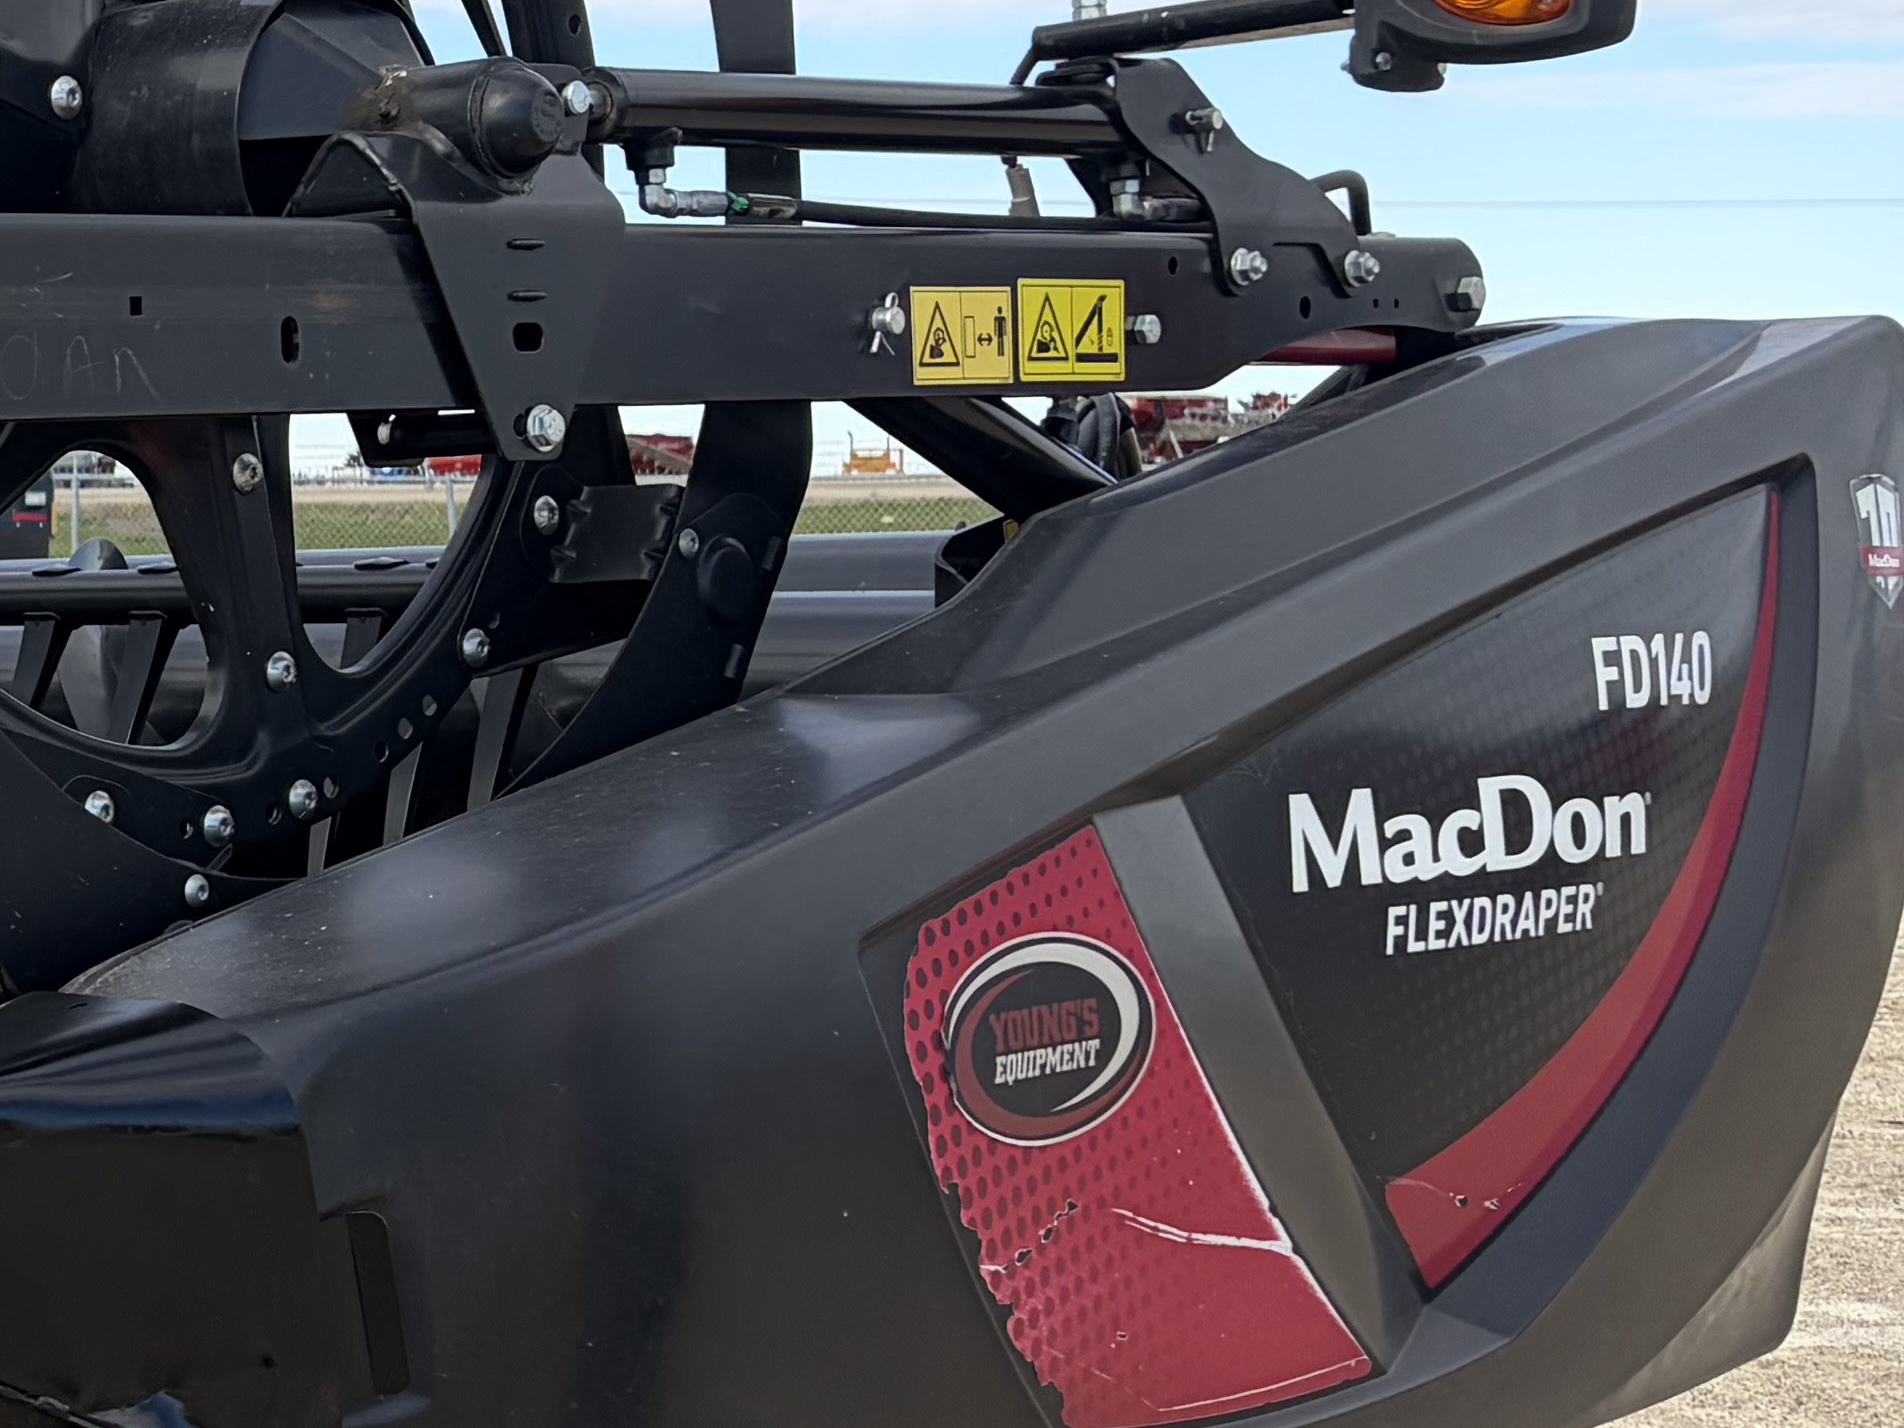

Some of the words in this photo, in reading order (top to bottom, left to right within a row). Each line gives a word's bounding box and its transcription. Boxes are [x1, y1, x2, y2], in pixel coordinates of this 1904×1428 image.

[1591, 630, 1712, 711] FD140
[1288, 774, 1648, 893] MacDon
[1385, 883, 1597, 956] FLEXDRAPER
[988, 997, 1100, 1054] YOUNG'S
[994, 1038, 1100, 1086] EQUIPMENT
